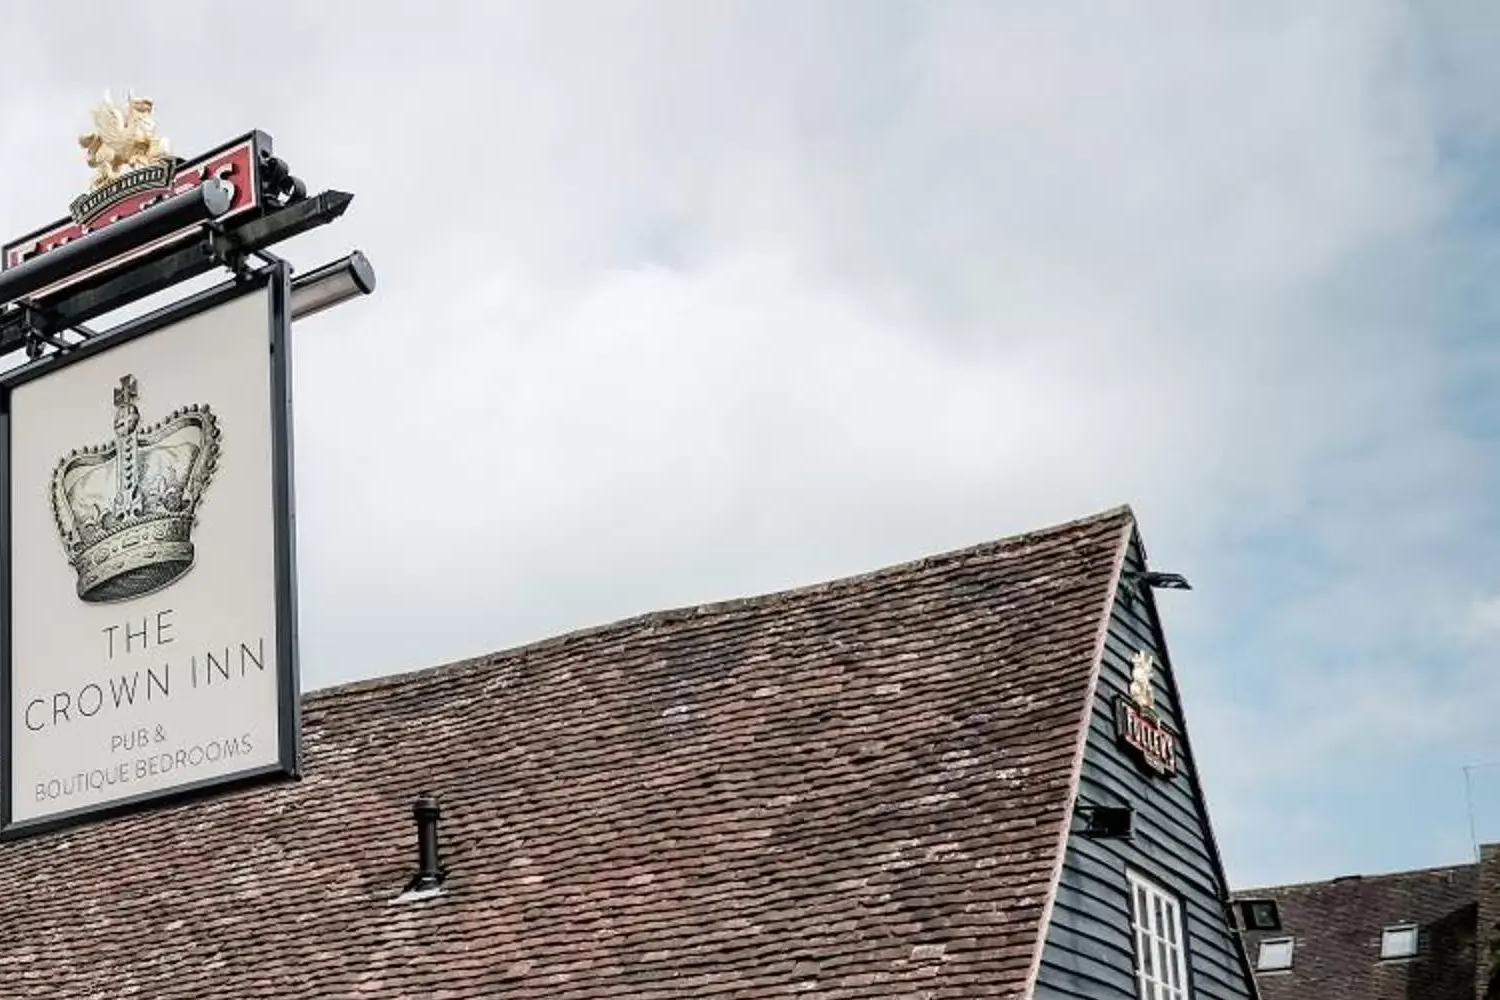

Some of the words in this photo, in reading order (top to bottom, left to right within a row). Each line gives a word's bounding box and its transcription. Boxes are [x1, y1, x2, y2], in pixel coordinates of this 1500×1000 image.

[102, 609, 174, 659] THE
[25, 663, 169, 731] CROWN
[191, 637, 264, 688] INN
[35, 762, 129, 801] BOUTIQUE
[135, 733, 253, 779] BEDROOMS
[111, 727, 150, 752] PUB
[154, 723, 166, 744] &
